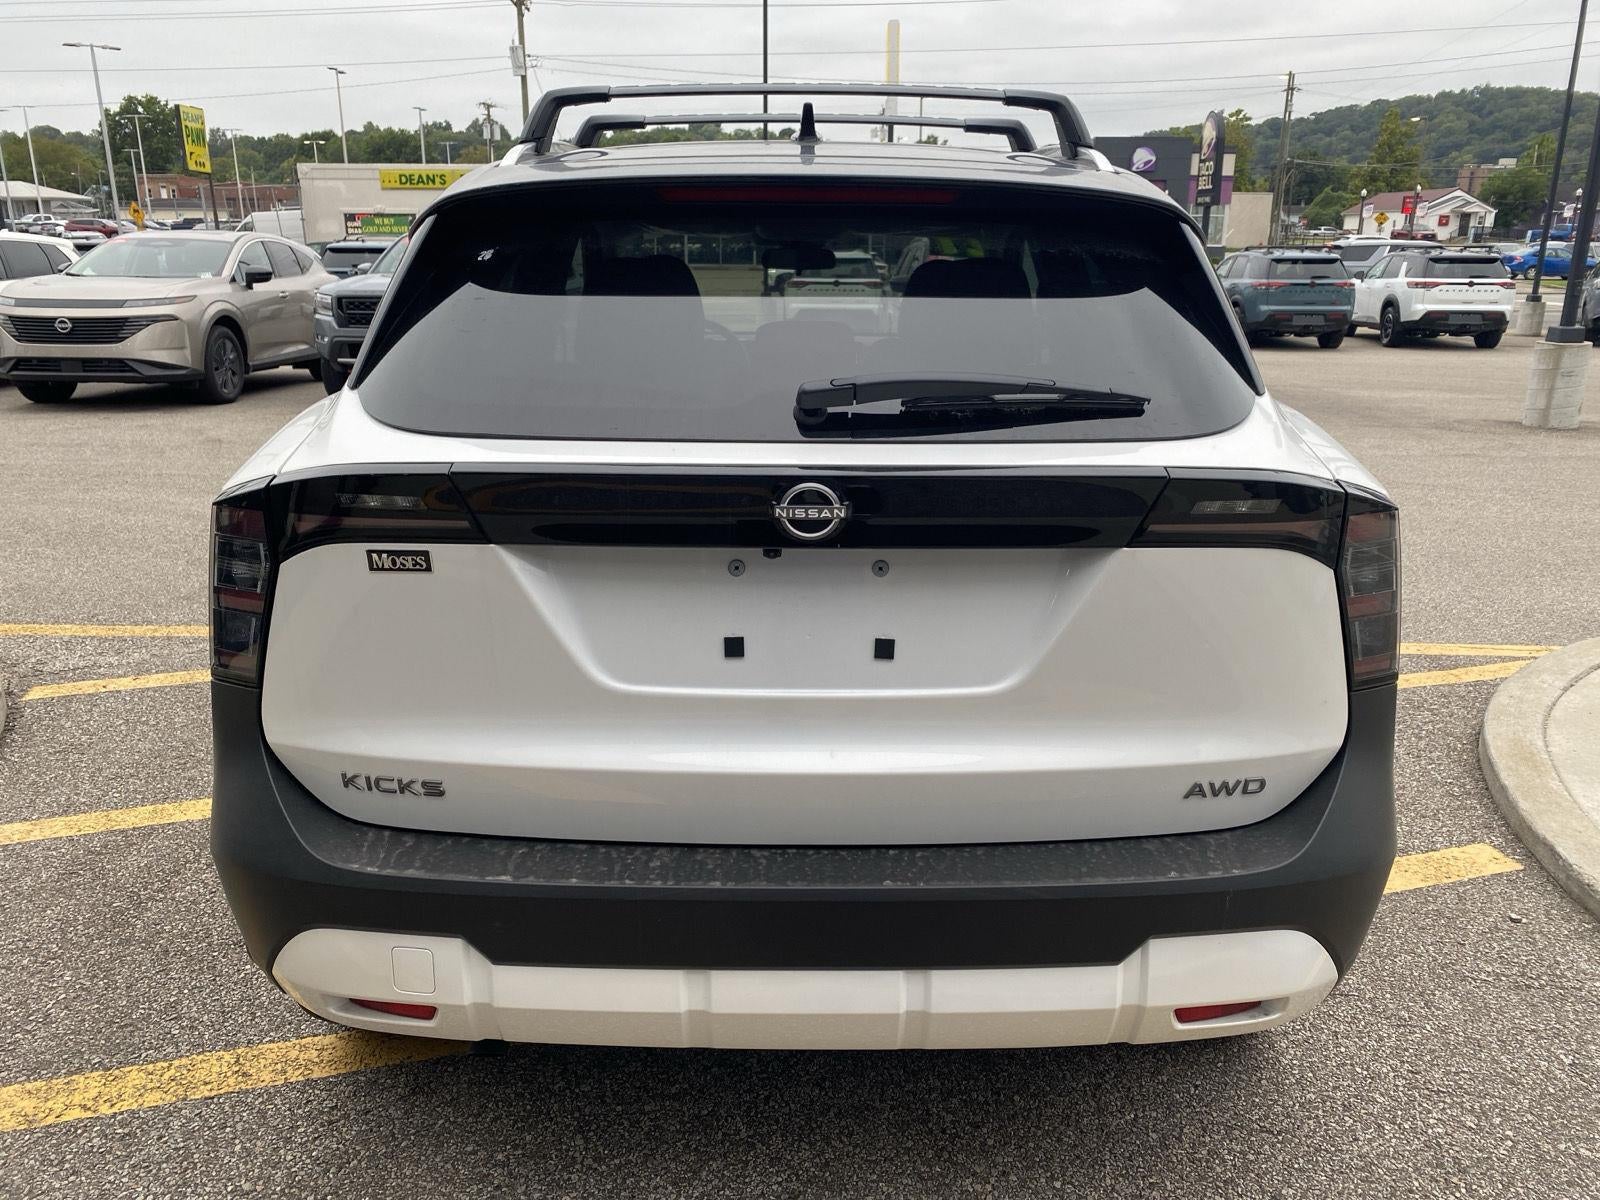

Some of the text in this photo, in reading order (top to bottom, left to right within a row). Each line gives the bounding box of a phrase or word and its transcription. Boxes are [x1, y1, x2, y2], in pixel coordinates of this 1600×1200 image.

[184, 124, 207, 149] PAWN
[1199, 161, 1214, 177] TACO
[398, 173, 447, 186] DEAN'S
[1197, 176, 1213, 190] BELL
[362, 225, 408, 233] GOLD AND SILVER
[775, 508, 845, 518] NISSAN
[371, 553, 427, 569] MOSES
[340, 771, 446, 797] KICKS
[1183, 777, 1267, 799] AWD
